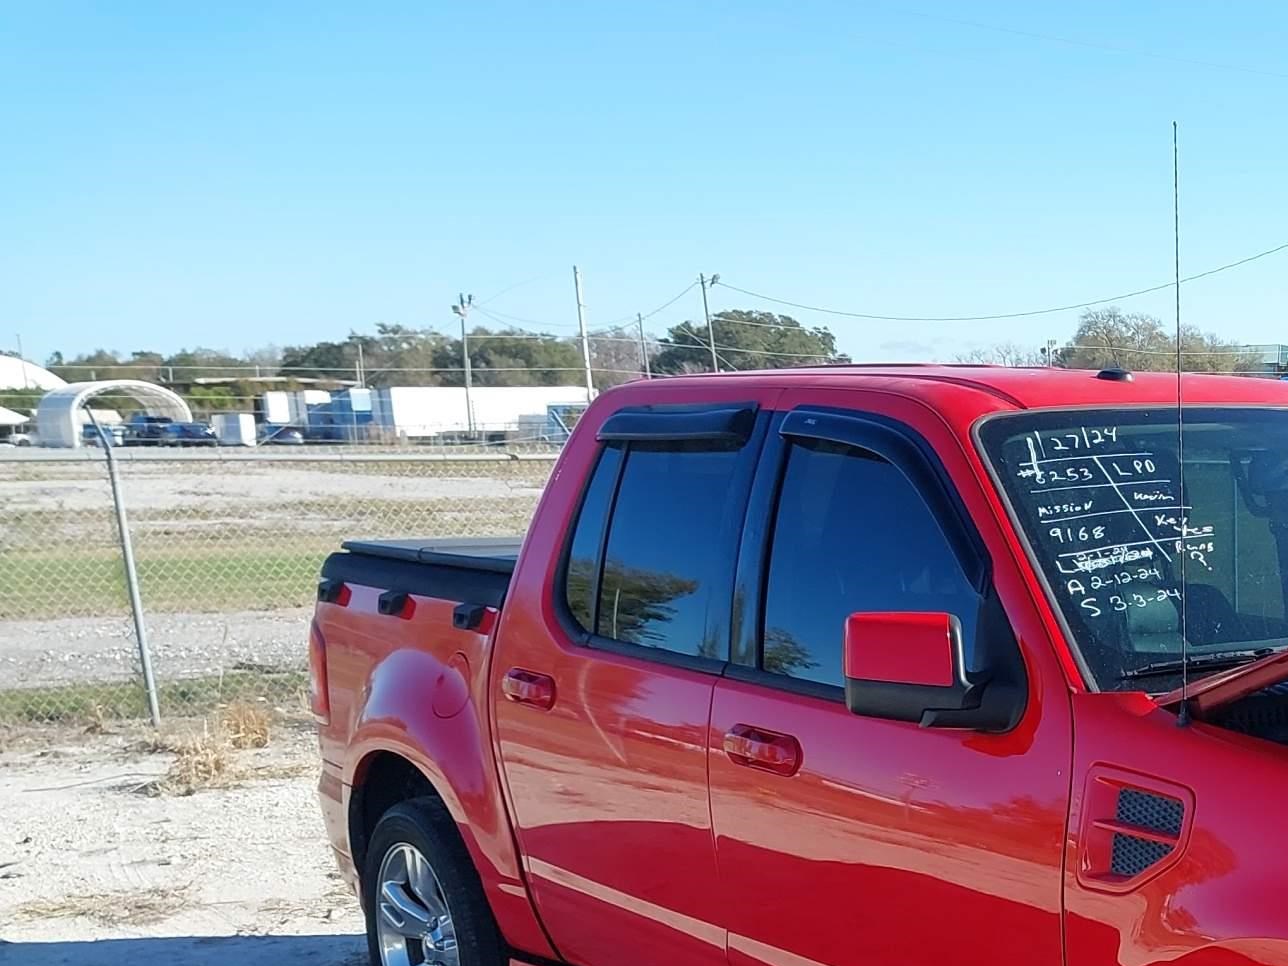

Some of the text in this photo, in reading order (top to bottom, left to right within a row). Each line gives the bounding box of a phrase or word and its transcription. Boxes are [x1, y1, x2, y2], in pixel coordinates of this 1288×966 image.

[1049, 525, 1106, 543] 9168
[1067, 568, 1162, 595] A 2-12-24
[1080, 598, 1101, 617] S
